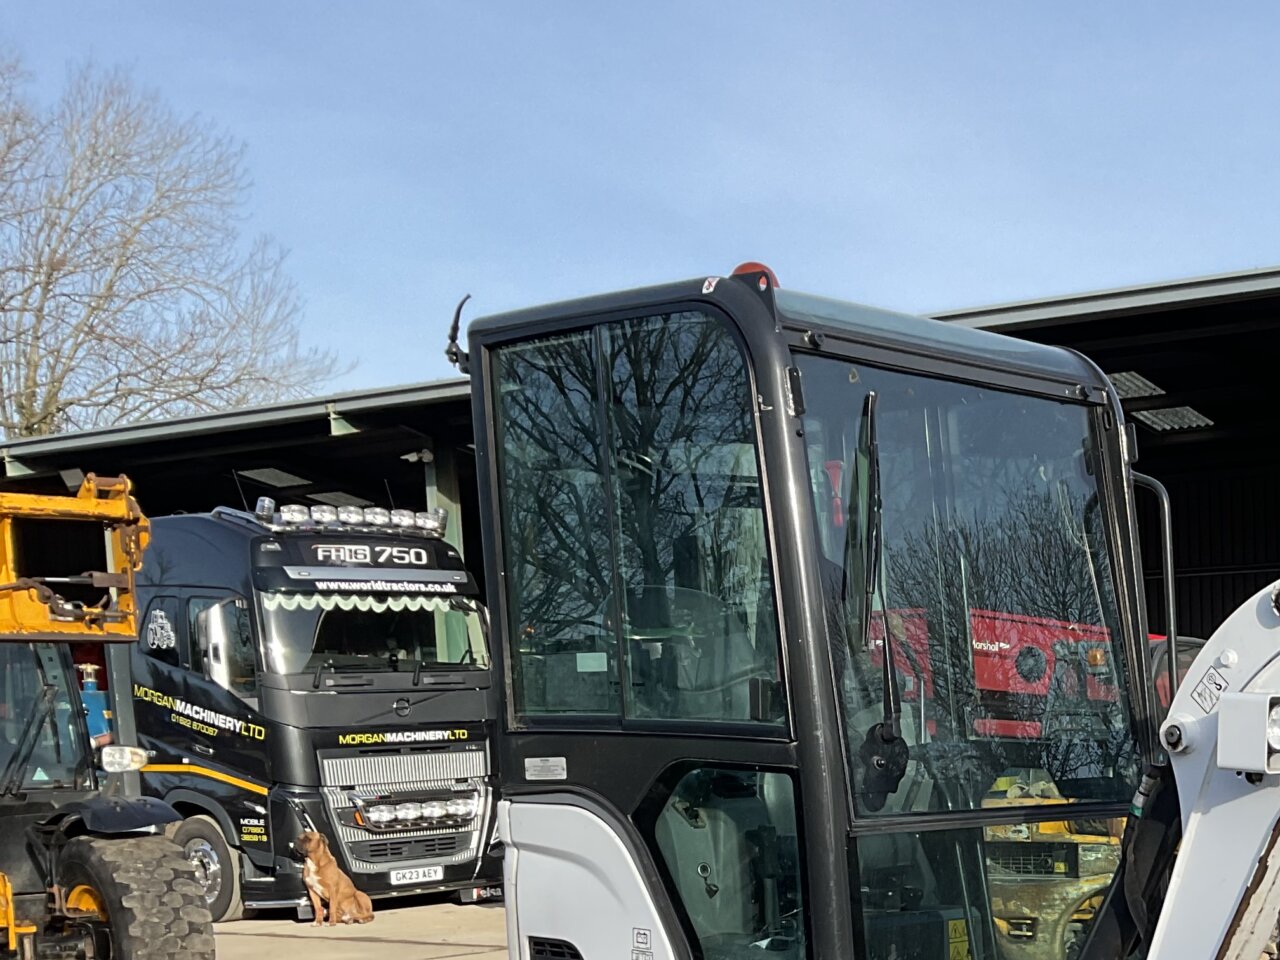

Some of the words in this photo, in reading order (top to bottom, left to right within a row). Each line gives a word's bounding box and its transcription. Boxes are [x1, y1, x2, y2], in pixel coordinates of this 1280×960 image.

[374, 546, 428, 565] 750
[315, 580, 457, 593] www.worldtractors.co.uk
[240, 818, 265, 826] MOBILE
[395, 870, 420, 882] GK23
[422, 867, 438, 879] AEY
